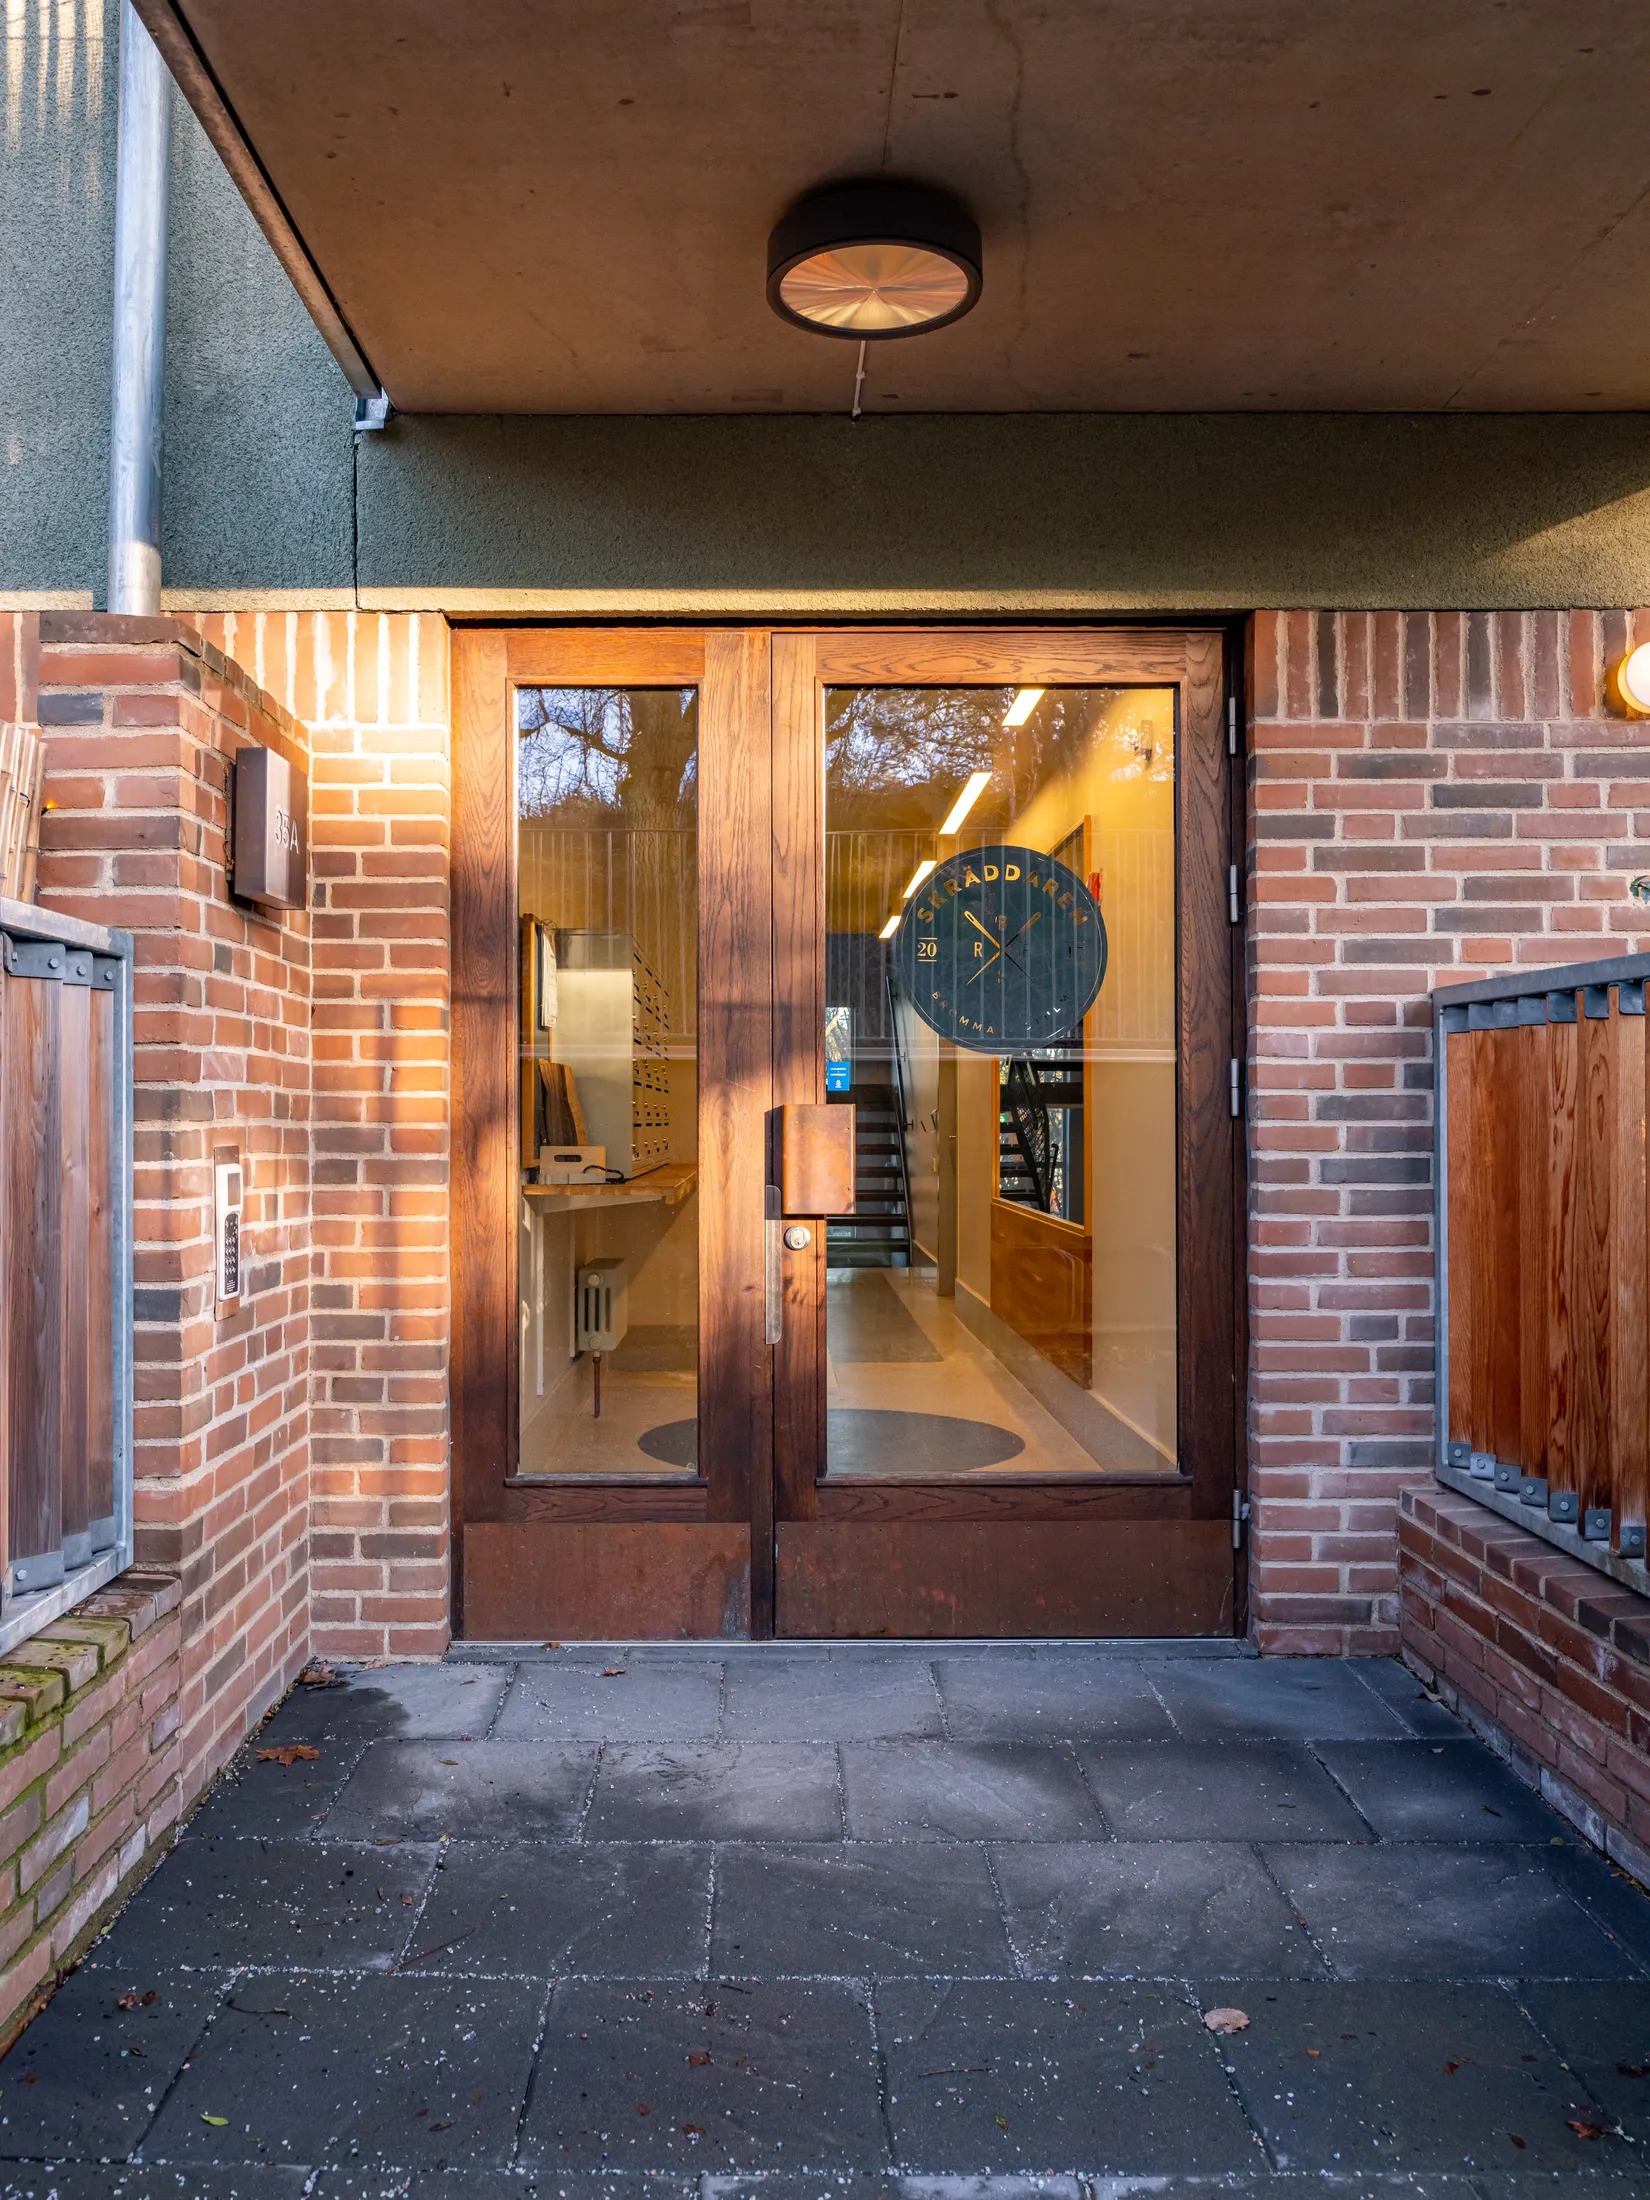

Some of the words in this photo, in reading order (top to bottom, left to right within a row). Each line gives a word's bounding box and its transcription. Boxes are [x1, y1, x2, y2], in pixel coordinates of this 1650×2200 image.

[275, 809, 299, 854] 35A
[917, 864, 1088, 927] SKRÄDDAREN
[917, 942, 937, 958] 20
[974, 942, 983, 958] R
[931, 991, 994, 1034] BROMMA
